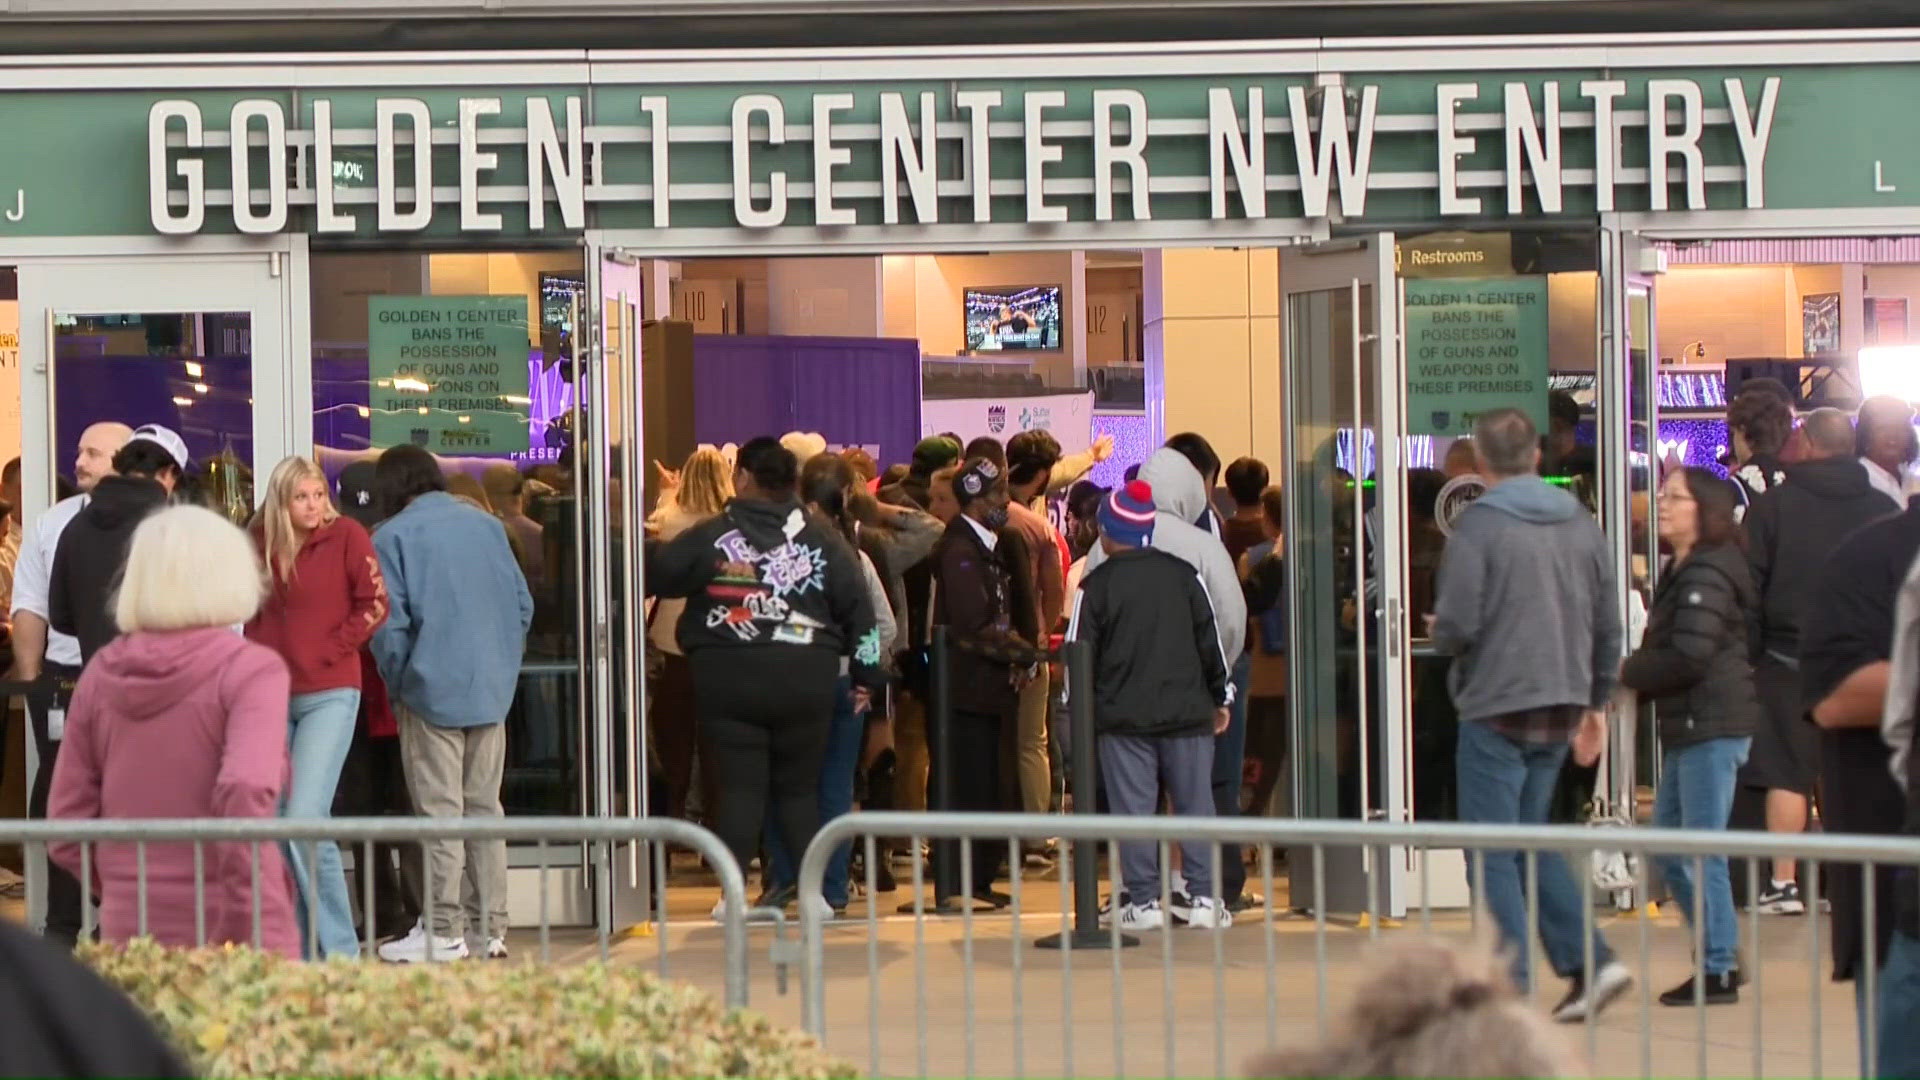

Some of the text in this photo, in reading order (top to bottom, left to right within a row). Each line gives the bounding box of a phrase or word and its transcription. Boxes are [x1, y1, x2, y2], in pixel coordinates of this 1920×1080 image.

[149, 76, 1781, 234] GOLDEN 1 CENTER NW ENTRY
[1875, 160, 1896, 191] L
[5, 189, 25, 222] J
[1411, 250, 1484, 264] Restrooms
[1405, 293, 1461, 306] GOLDEN
[1477, 292, 1537, 305] CENTER
[378, 310, 441, 323] GOLDEN
[457, 309, 517, 322] CENTER
[1432, 310, 1504, 324] BANS THE
[411, 327, 485, 341] BANS THE
[1421, 328, 1516, 341] POSSESSION
[400, 345, 497, 358] POSSESSION
[1419, 345, 1519, 359] OF GUNS AND
[398, 363, 499, 375] OF GUNS AND
[1419, 363, 1519, 377] WEAPONS ON
[400, 381, 499, 393] PONS ON
[1407, 380, 1533, 394] THESE PREMISES
[386, 398, 513, 411] THESE PREMISES
[440, 437, 491, 446] CENTER
